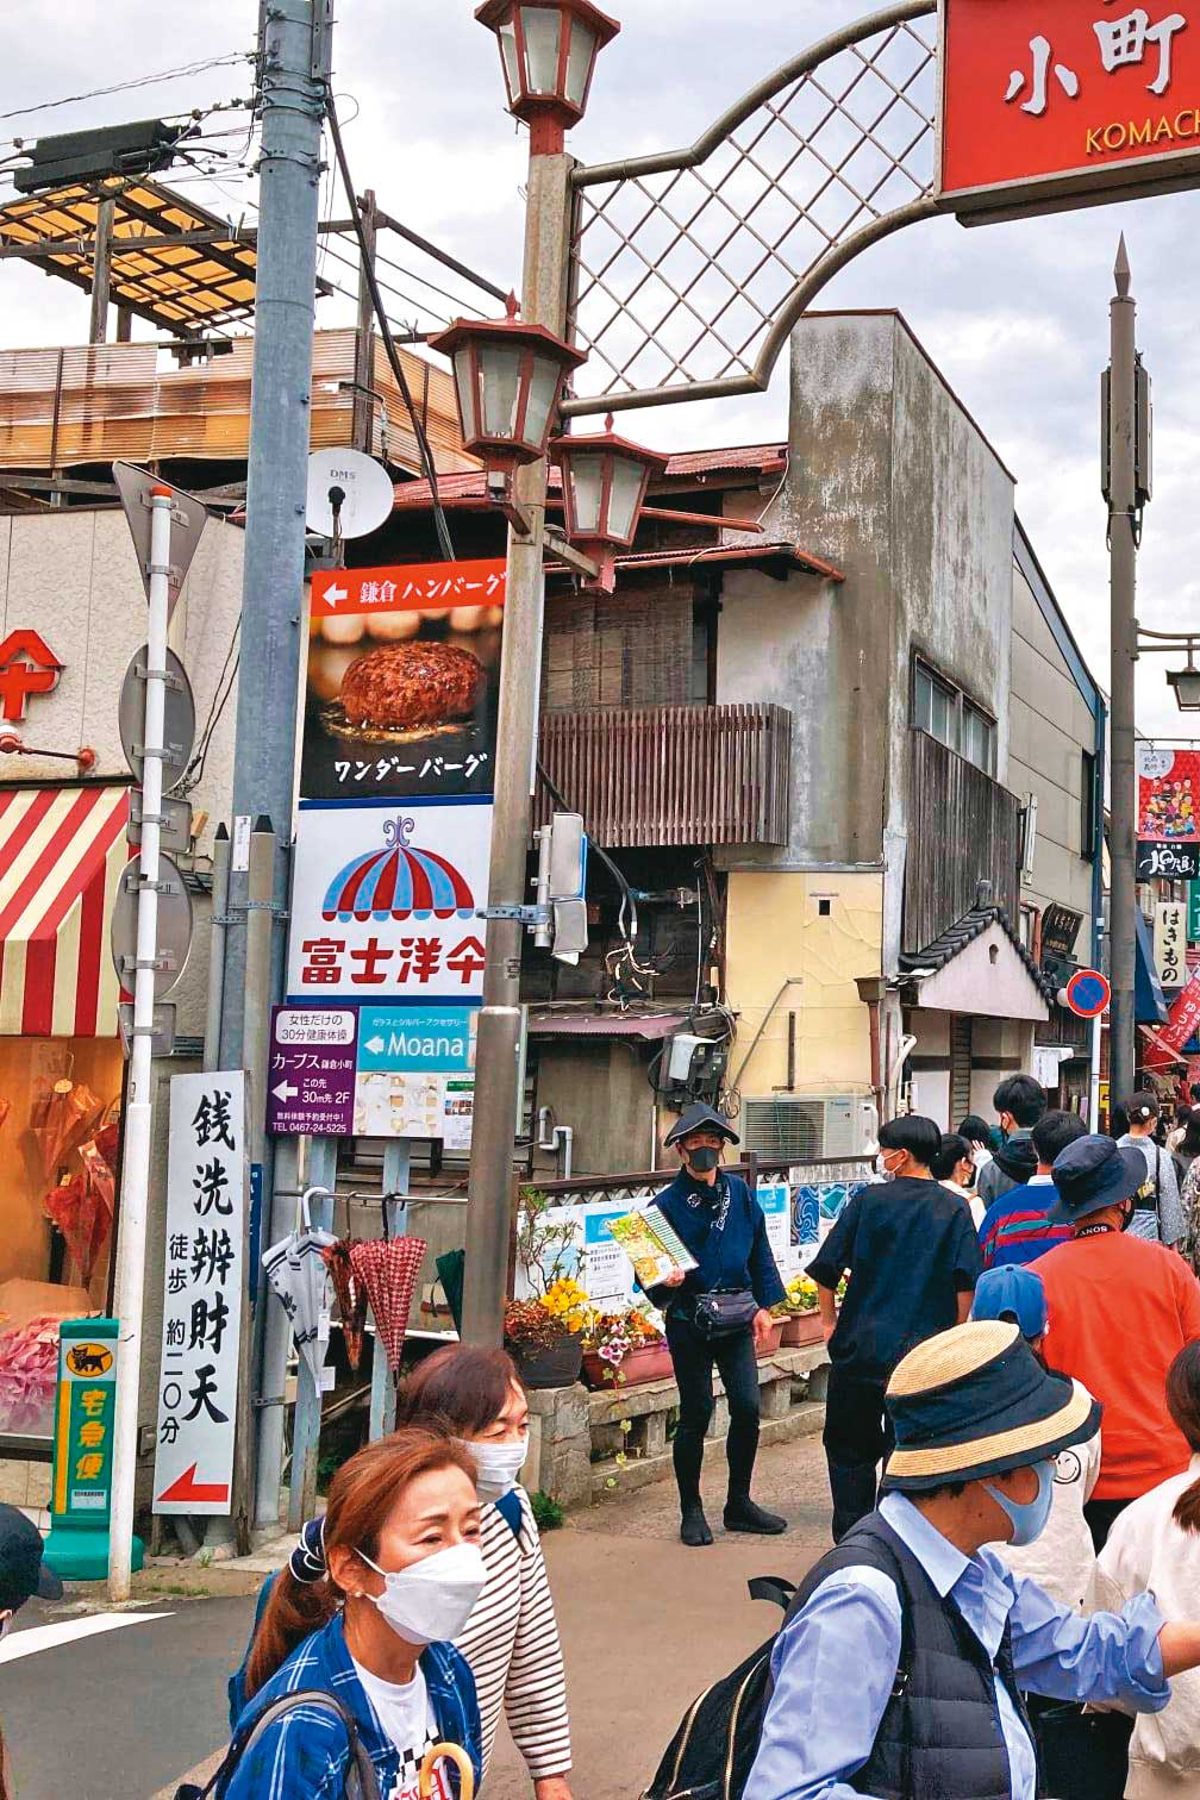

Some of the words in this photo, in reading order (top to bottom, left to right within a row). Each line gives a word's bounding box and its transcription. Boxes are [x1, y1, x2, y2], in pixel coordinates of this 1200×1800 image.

[334, 752, 488, 782] ワンダーバーグ
[1161, 909, 1180, 983] はきもの
[288, 1013, 343, 1026] 女性だけの
[281, 1029, 348, 1041] 30分健康体操
[387, 1031, 464, 1057] Moana
[302, 1078, 328, 1089] この先
[335, 1092, 351, 1104] 2F
[272, 1122, 288, 1132] TEL
[289, 1122, 347, 1133] 0467-24-5225
[168, 1233, 190, 1294] 徒歩
[75, 1390, 107, 1480] 宅急便
